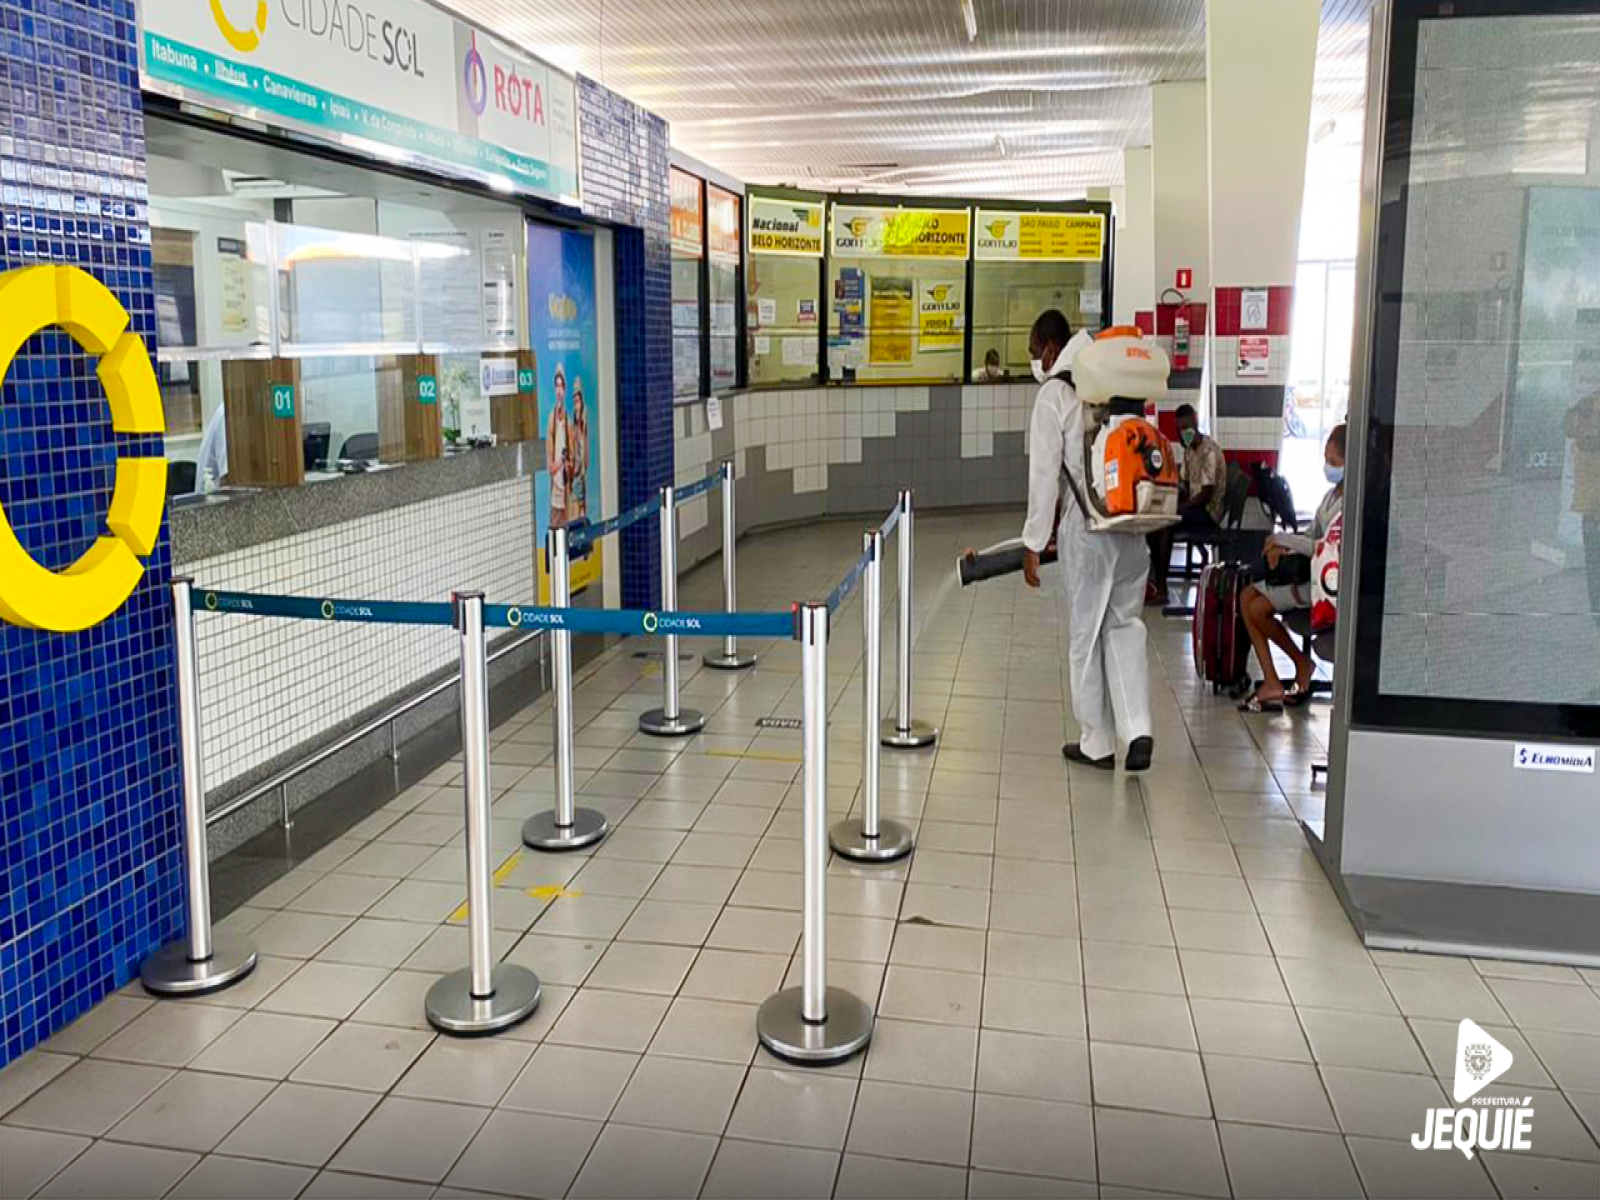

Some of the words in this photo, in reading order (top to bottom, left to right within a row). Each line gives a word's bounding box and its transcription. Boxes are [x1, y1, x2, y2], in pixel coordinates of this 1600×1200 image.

[152, 39, 197, 71] Itabuna
[494, 63, 545, 126] ROTA
[753, 218, 799, 233] Nacional
[1038, 218, 1060, 228] PAULO
[1065, 219, 1102, 230] CAMPINAS
[752, 234, 773, 248] BELO
[775, 235, 821, 250] HORIZONTE
[520, 372, 533, 386] 03
[419, 381, 436, 398] 02
[274, 390, 291, 411] 01
